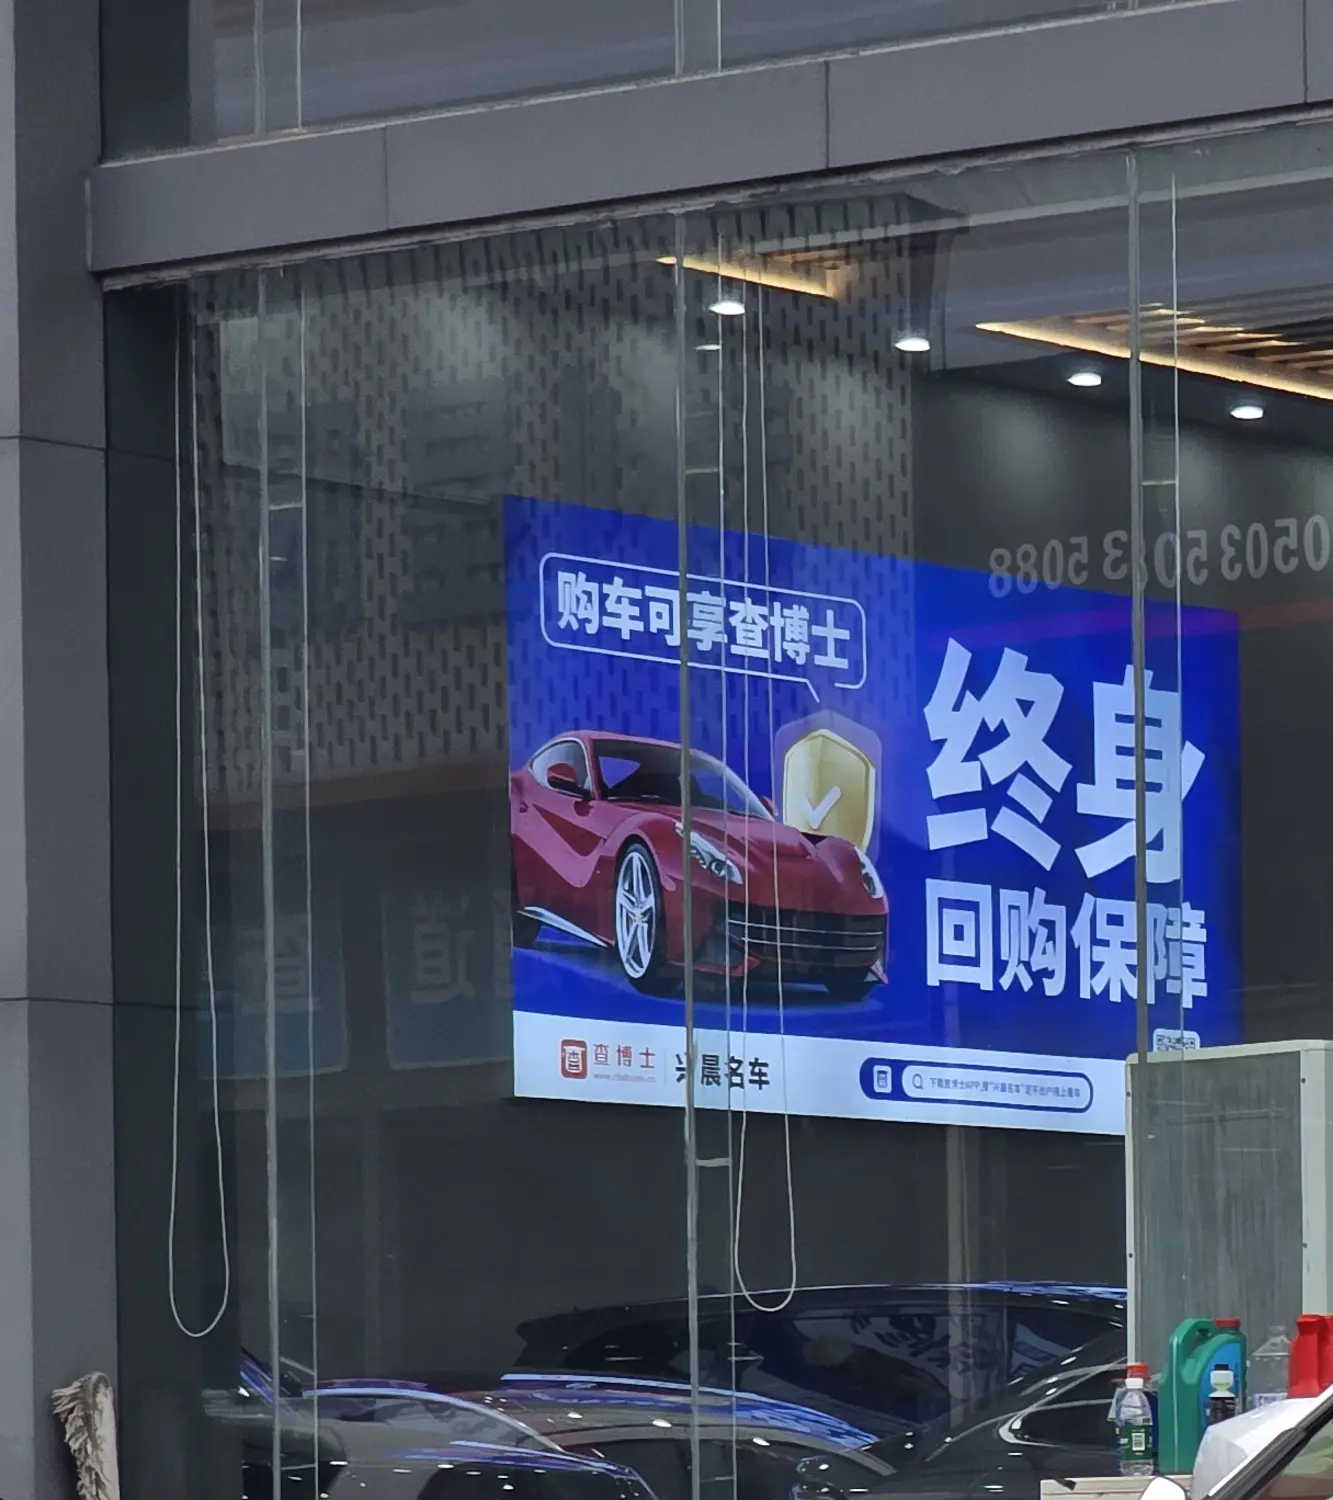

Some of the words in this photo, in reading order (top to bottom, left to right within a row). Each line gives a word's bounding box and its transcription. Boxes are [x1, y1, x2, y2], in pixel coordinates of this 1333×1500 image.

[557, 571, 850, 669] 购车可享查博士
[923, 637, 1205, 883] 终身
[924, 877, 1207, 1008] 回购保障
[593, 1043, 656, 1069] 查博士
